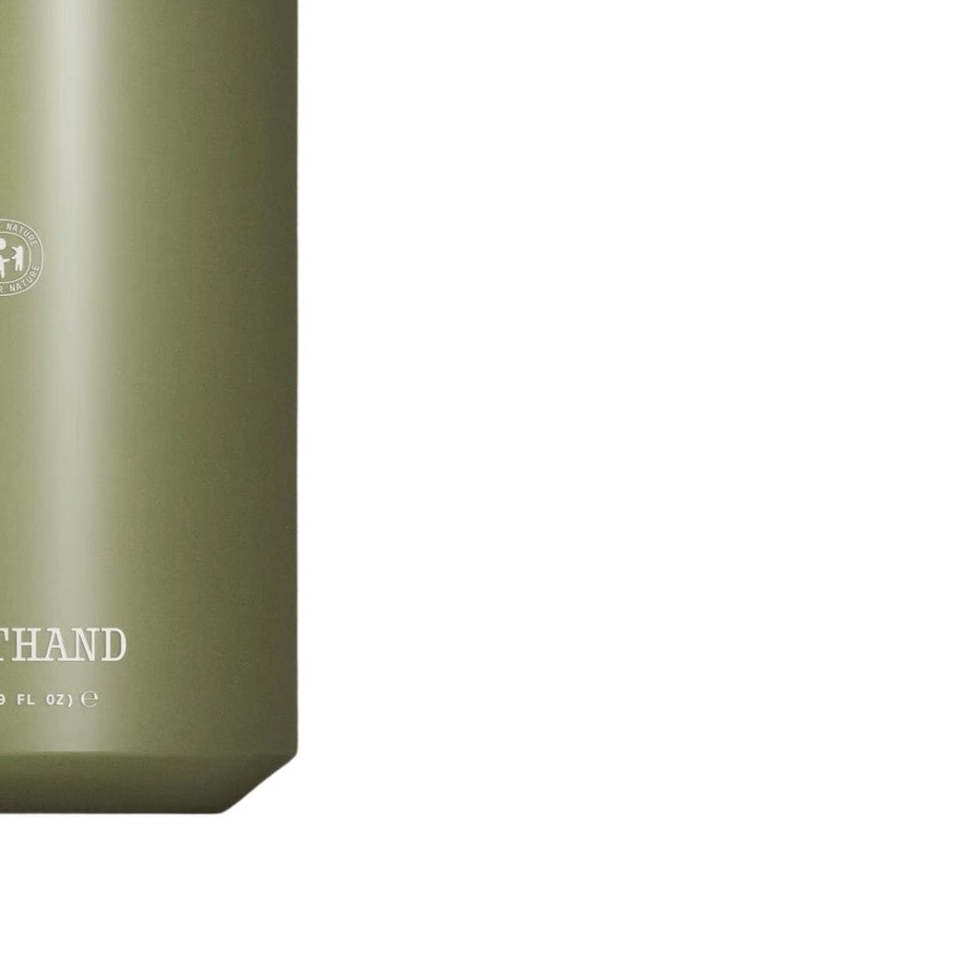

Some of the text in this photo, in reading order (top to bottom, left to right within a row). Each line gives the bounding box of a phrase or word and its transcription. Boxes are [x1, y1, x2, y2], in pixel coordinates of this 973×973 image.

[6, 222, 39, 248] NATURE
[9, 265, 40, 292] NATURE
[17, 693, 36, 706] FL
[46, 693, 74, 708] OZ)
